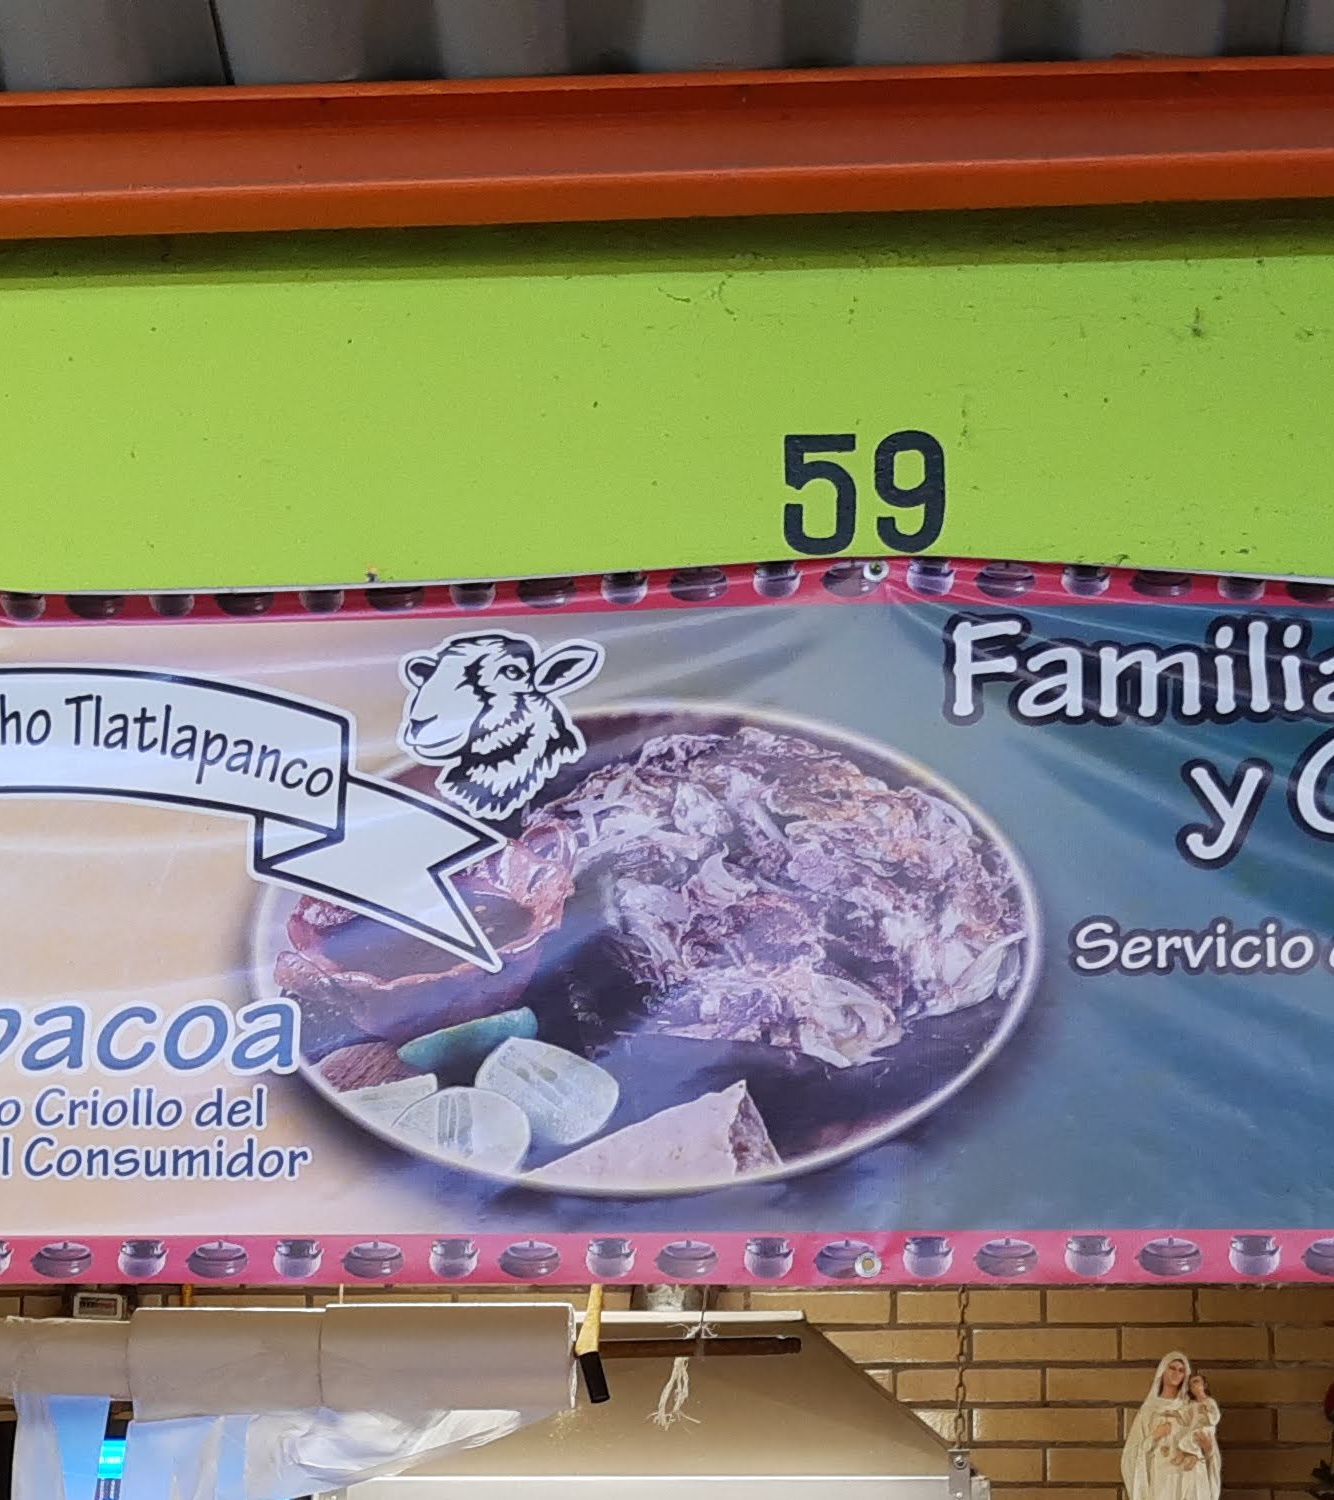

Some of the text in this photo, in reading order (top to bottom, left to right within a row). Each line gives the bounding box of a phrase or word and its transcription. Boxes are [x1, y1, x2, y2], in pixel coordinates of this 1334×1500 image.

[783, 431, 946, 554] 59
[65, 694, 335, 797] Tlatlapanco
[1186, 763, 1263, 861] y
[1075, 921, 1315, 972] Servicio
[36, 1090, 183, 1129] Criollo
[195, 1089, 265, 1129] del
[24, 1137, 311, 1180] Consumidor
